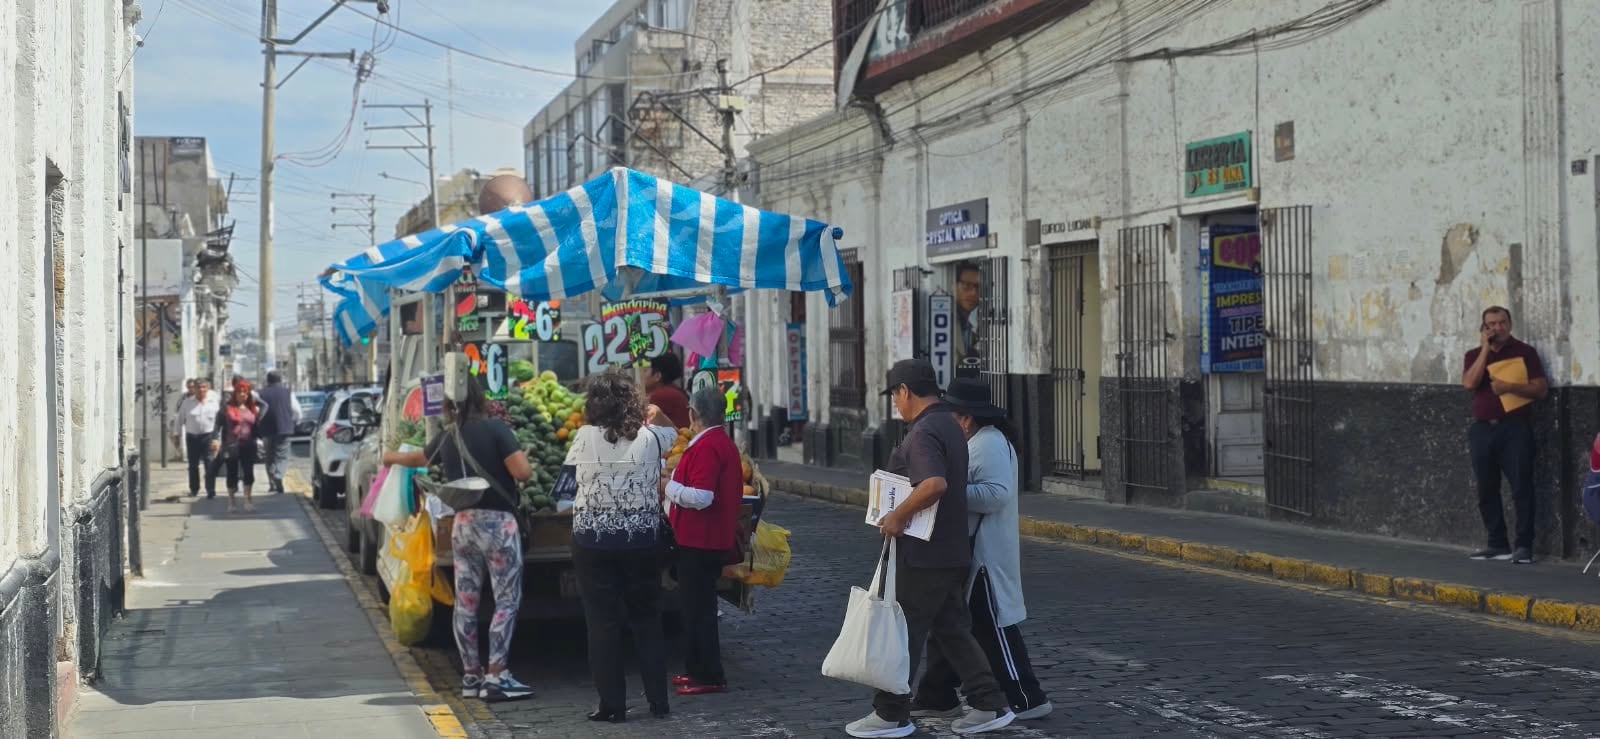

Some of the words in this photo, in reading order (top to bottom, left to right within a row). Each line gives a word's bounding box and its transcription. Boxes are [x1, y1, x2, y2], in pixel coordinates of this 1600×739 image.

[954, 223, 981, 241] WORLD
[602, 299, 667, 321] Mandarina
[1221, 332, 1264, 351] INTER
